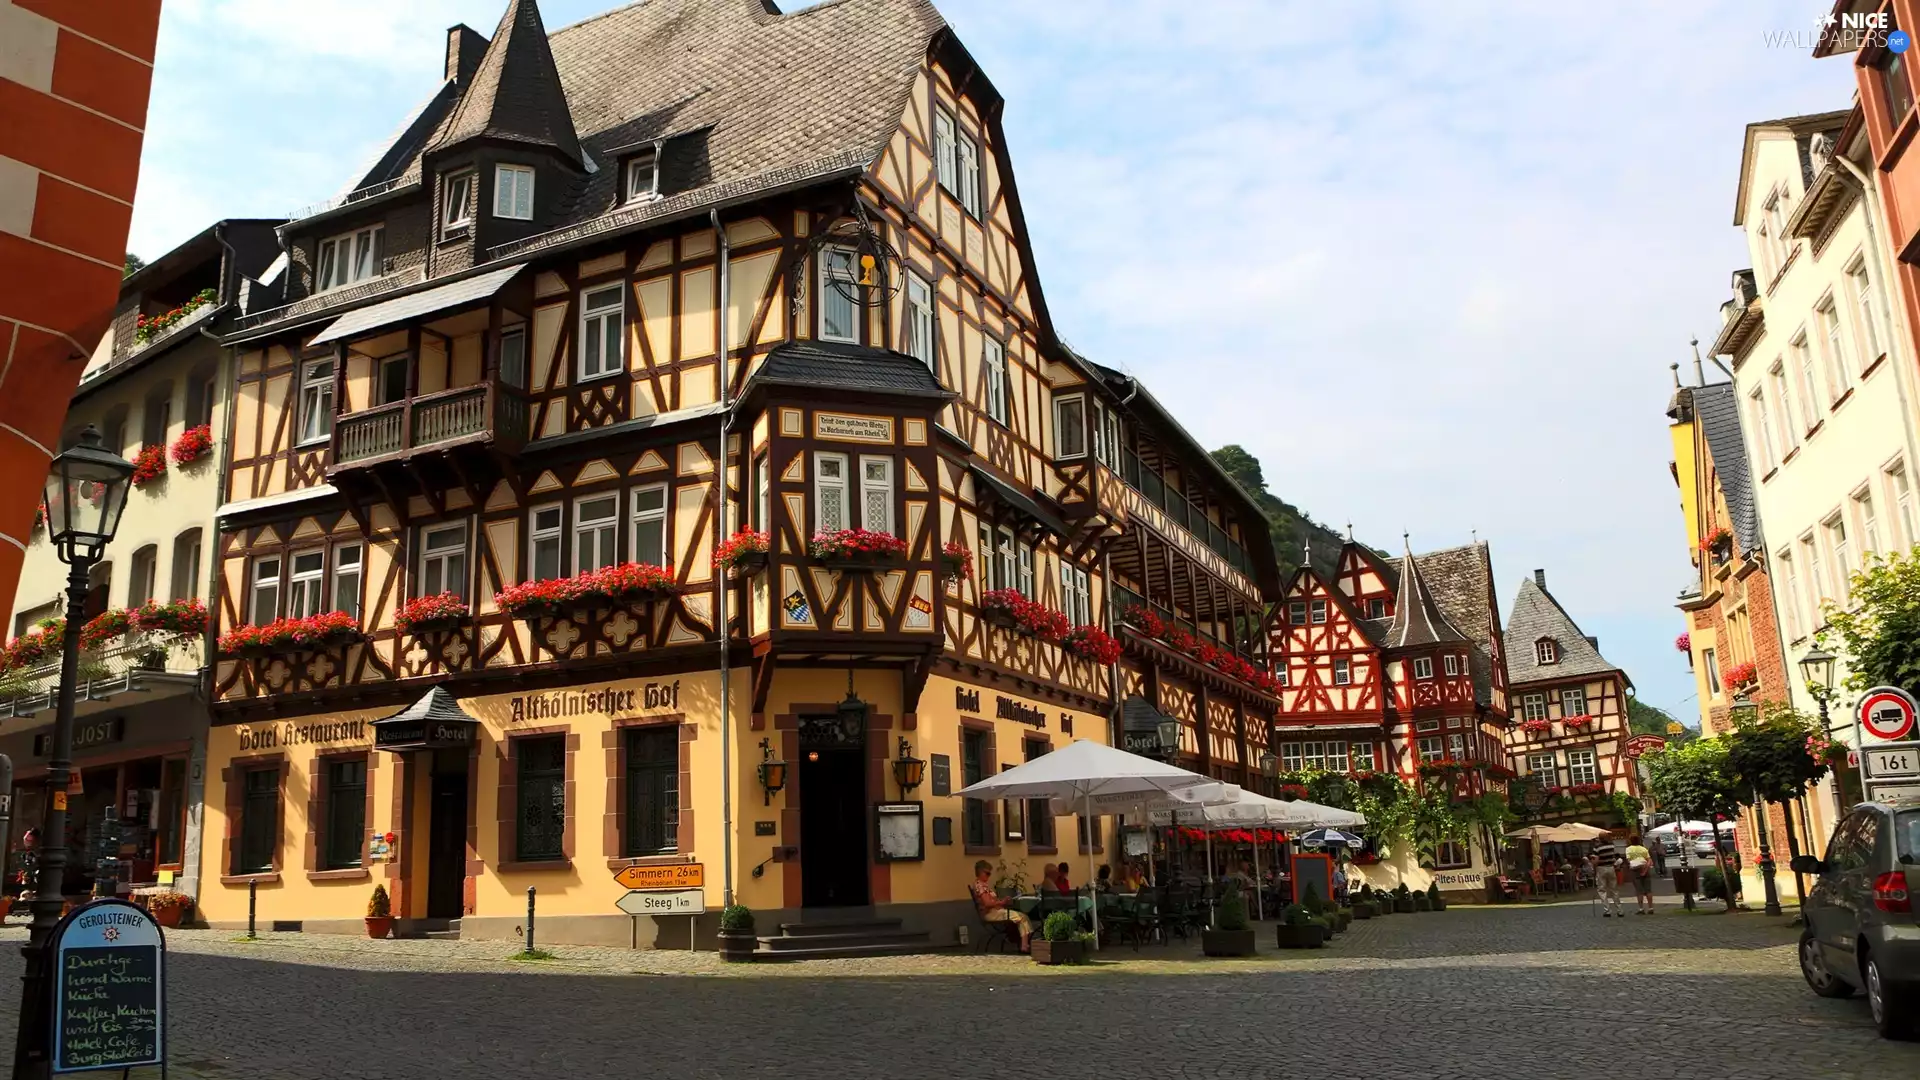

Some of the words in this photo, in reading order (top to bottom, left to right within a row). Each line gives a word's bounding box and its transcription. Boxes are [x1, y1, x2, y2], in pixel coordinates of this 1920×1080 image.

[511, 687, 635, 722] Altkölnischer
[644, 680, 680, 710] Hof
[956, 686, 980, 713] Hotel
[77, 722, 113, 745] JOST
[239, 723, 278, 750] Hotel
[282, 718, 365, 746] Restaurant
[435, 725, 469, 741] Hotel
[1123, 733, 1157, 751] Hotel
[629, 868, 673, 879] Simmern
[644, 897, 672, 910] Steeg
[79, 912, 144, 930] GEROLSTEINER
[68, 986, 110, 1001] Küche
[66, 1022, 99, 1036] und
[101, 1020, 123, 1033] Eis
